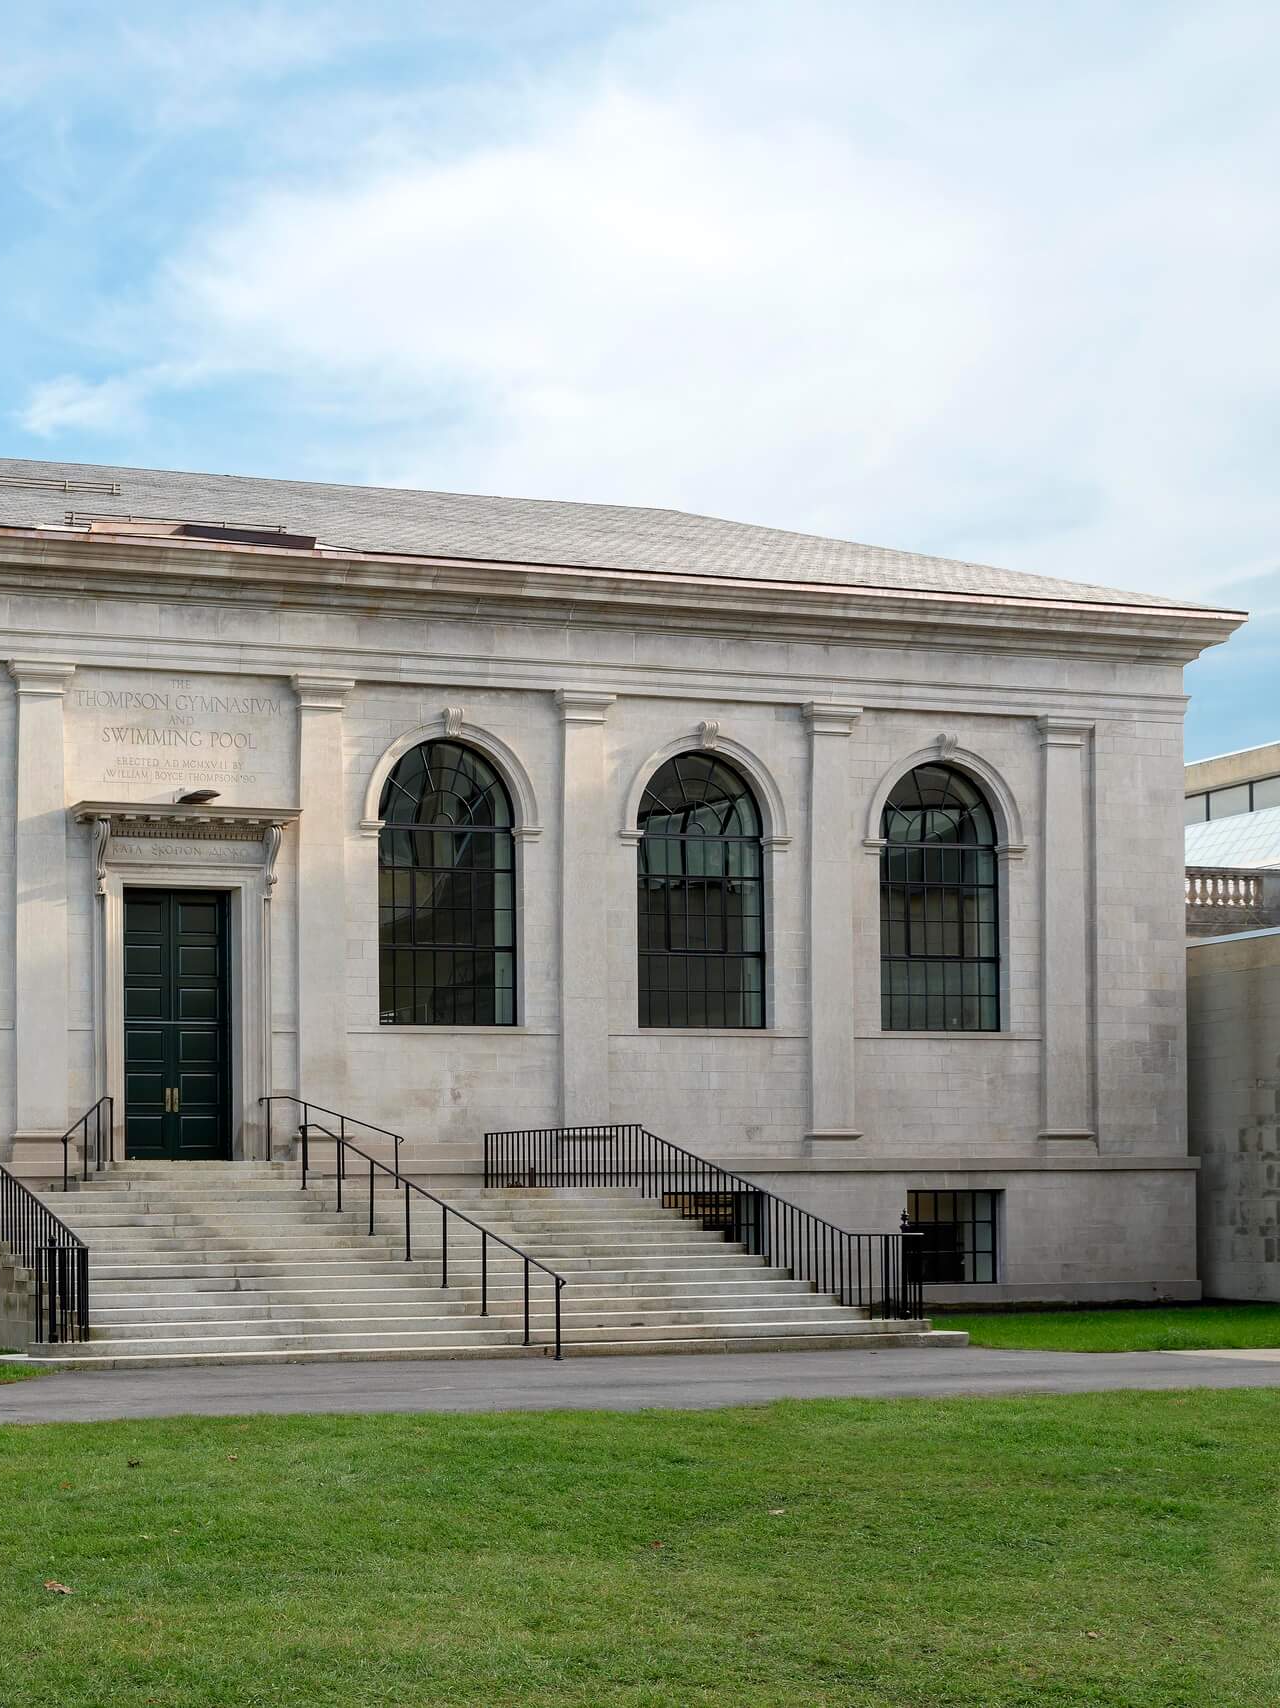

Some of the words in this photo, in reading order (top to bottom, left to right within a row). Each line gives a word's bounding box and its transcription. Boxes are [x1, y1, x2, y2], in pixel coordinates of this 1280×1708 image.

[171, 679, 191, 689] THE
[76, 690, 169, 711] THOMPSON
[175, 694, 282, 715] GYMNASIVM
[169, 715, 194, 726] AND
[102, 727, 202, 747] SWIMMING
[211, 731, 257, 750] POOL
[116, 756, 160, 767] ERECTED
[232, 760, 244, 771] BY
[105, 767, 149, 779] WILLIAM
[154, 769, 185, 781] BOYCE
[188, 772, 239, 785] THOMPSON
